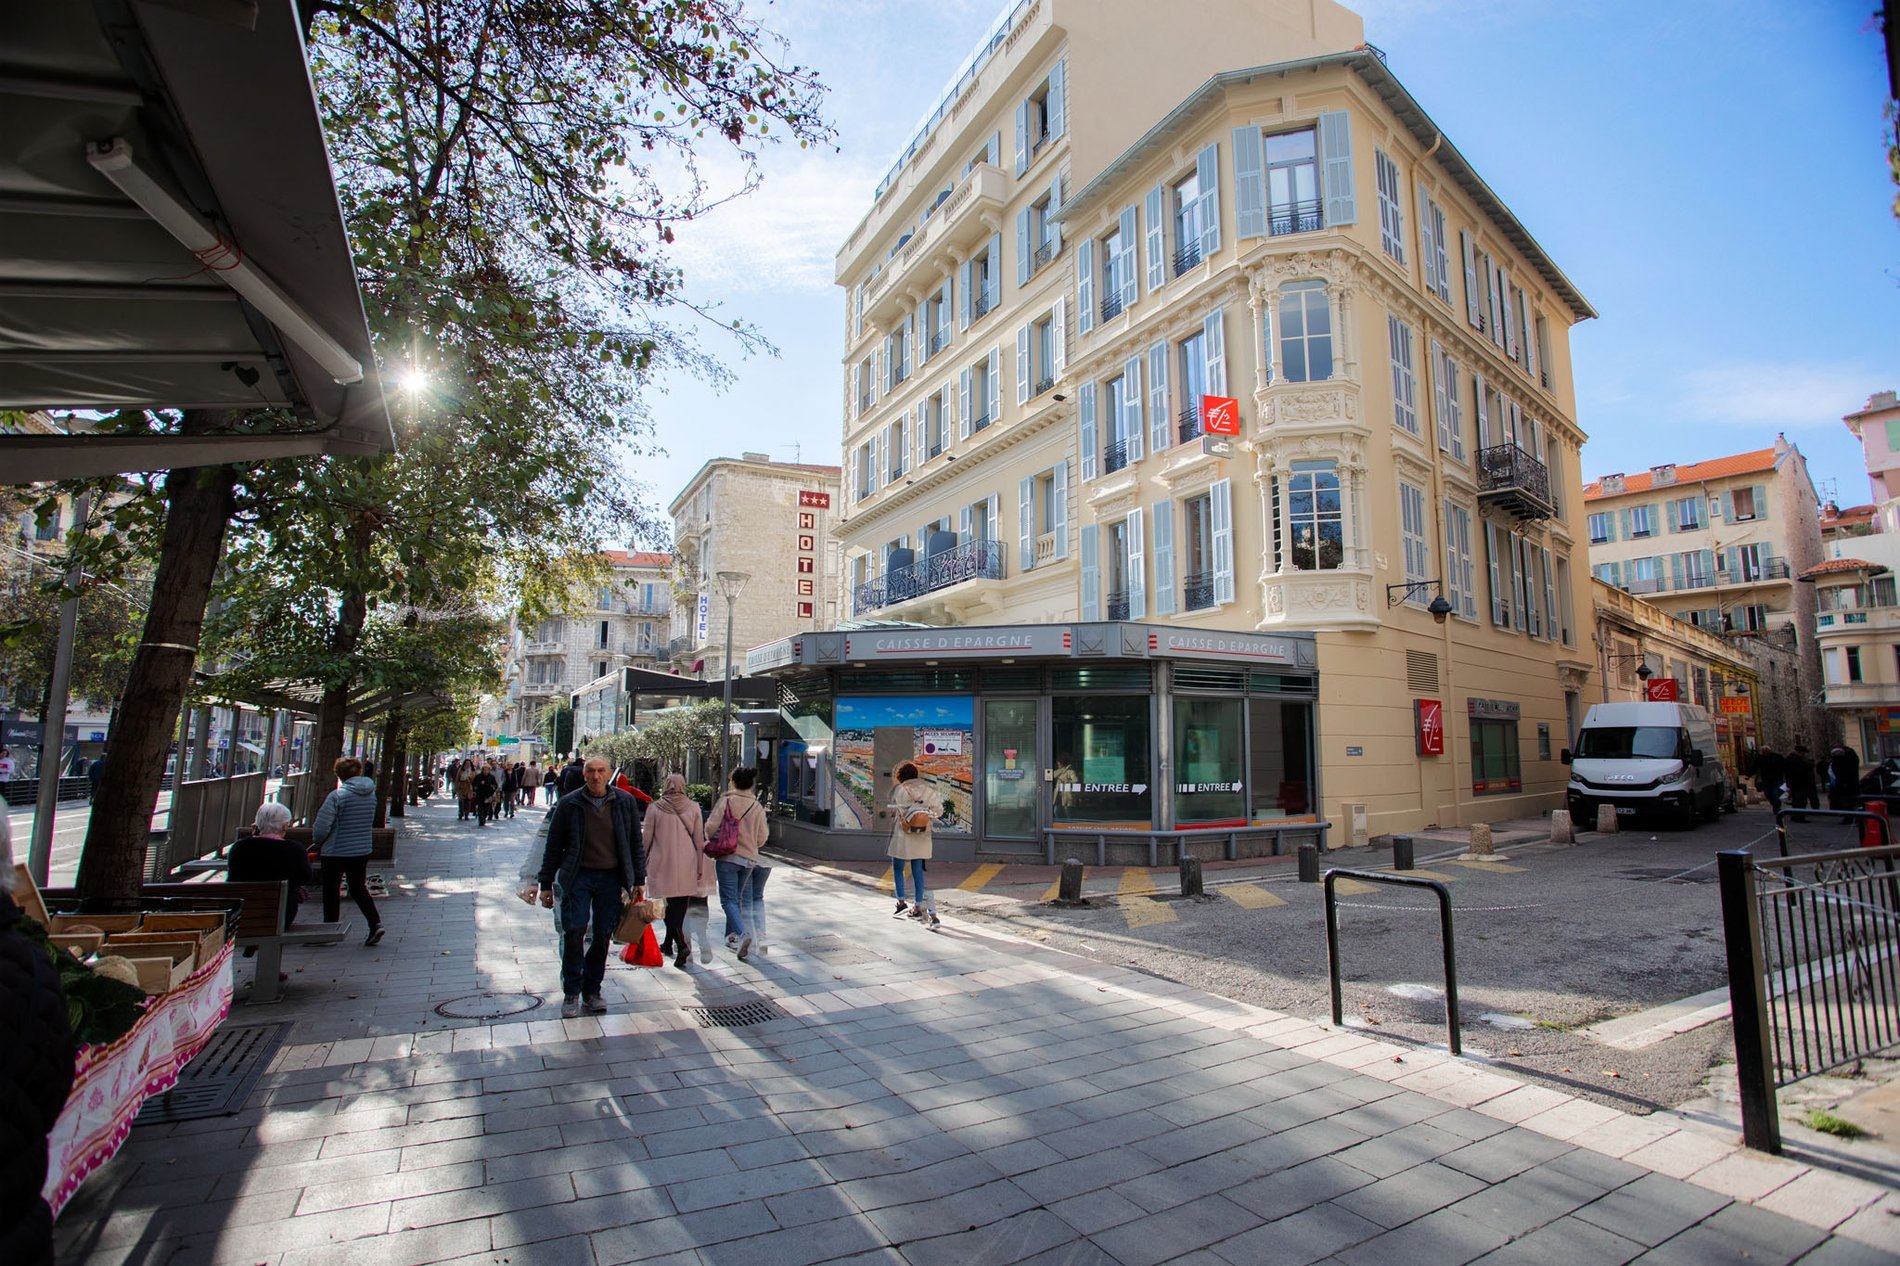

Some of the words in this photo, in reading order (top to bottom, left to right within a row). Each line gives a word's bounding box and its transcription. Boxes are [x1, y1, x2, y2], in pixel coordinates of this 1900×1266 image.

[800, 514, 813, 617] HOTEL
[699, 596, 707, 640] HOTEL
[876, 638, 931, 650] CAISSE
[937, 635, 1033, 648] D'EPARGNE
[1168, 636, 1213, 649] CAISSE
[1218, 640, 1285, 655] D'EPARGNE
[1720, 705, 1750, 713] VENTE
[1084, 783, 1130, 793] ENTREE
[1197, 783, 1231, 792] ENTREE
